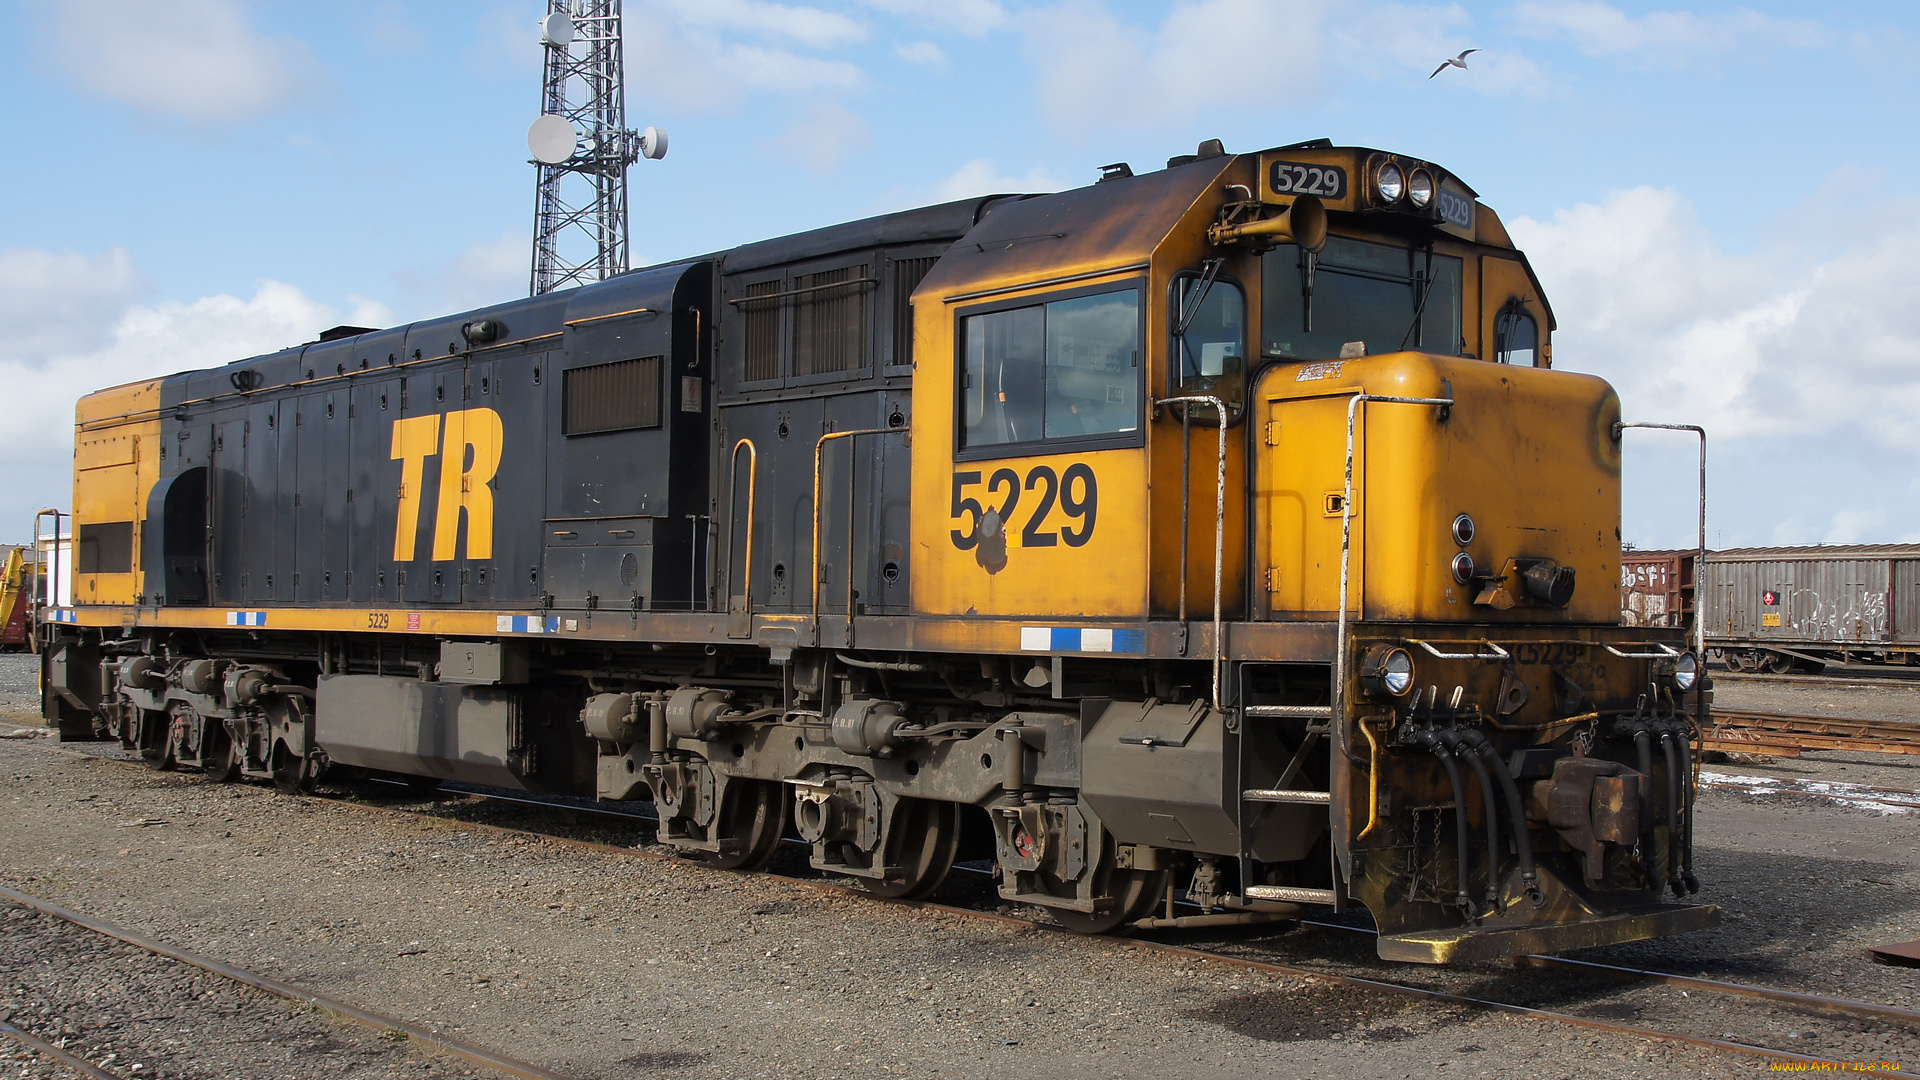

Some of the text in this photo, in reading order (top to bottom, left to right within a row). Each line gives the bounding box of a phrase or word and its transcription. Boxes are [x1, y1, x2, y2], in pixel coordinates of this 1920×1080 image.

[1277, 164, 1340, 196] 5229
[1440, 193, 1469, 226] 5229
[390, 407, 504, 562] TR
[950, 463, 1098, 550] 5229
[368, 612, 390, 629] 5229
